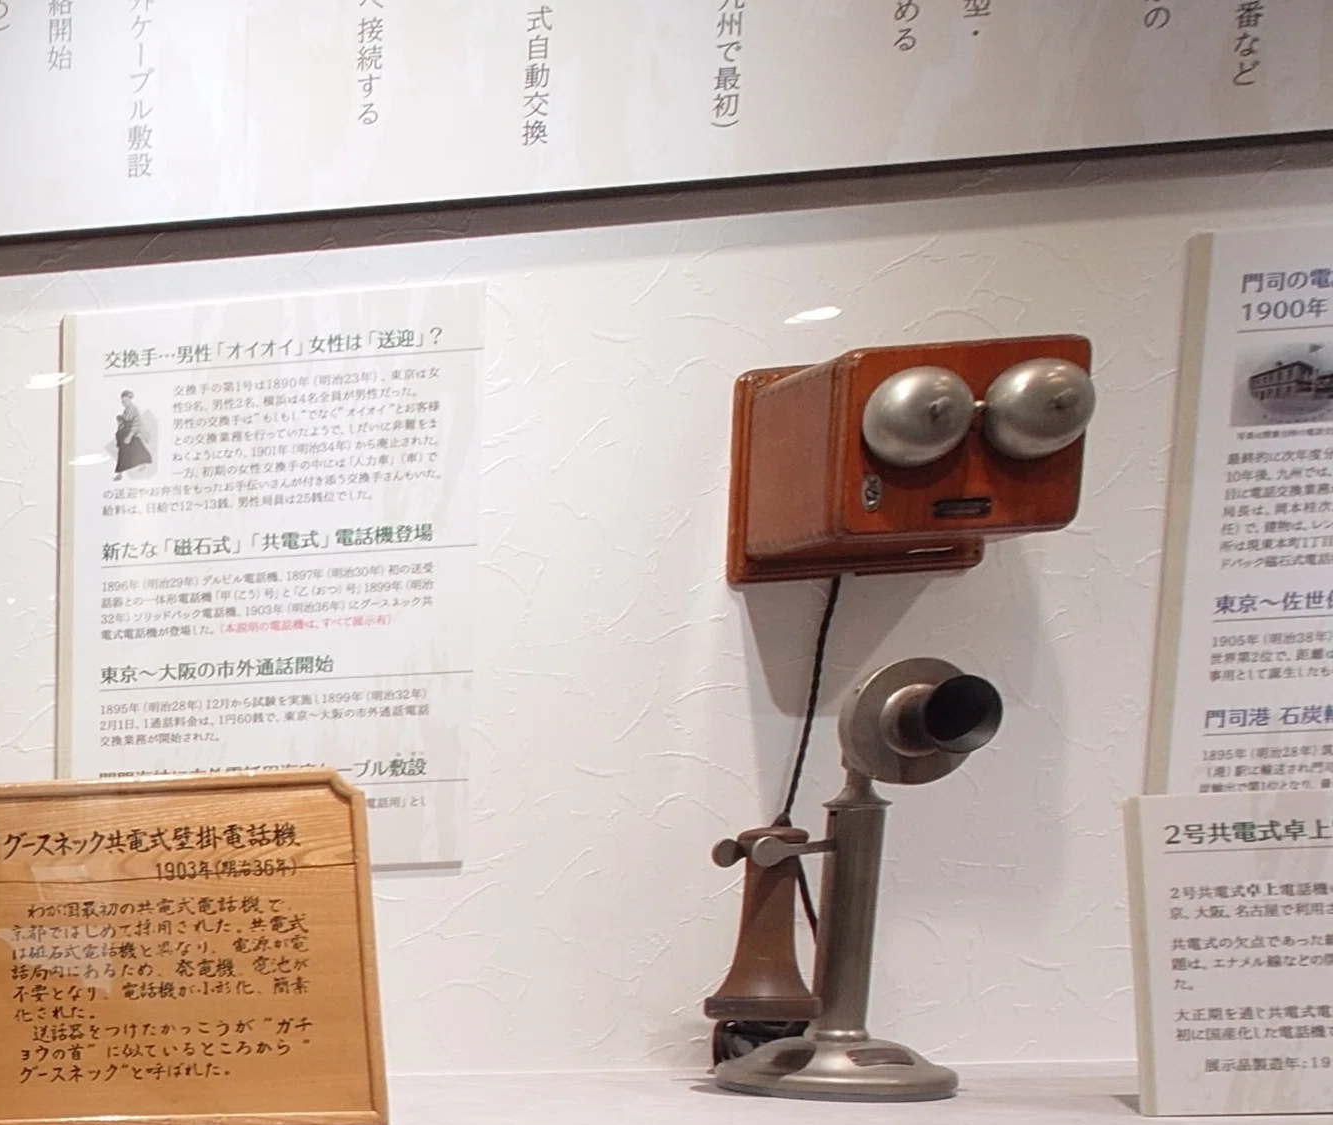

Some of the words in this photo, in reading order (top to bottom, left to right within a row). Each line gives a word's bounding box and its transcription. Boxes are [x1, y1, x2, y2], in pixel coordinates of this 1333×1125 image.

[893, 0, 920, 52] める
[1144, 0, 1171, 30] の
[1231, 0, 1264, 87] 番など
[522, 4, 553, 147] 式自動交換
[1241, 268, 1333, 294] 門司の電
[1242, 297, 1329, 321] 1900年
[1204, 707, 1271, 728] 門司港
[2, 822, 302, 862] グースネック共電式壁掛電話機
[1163, 818, 1333, 845] 2号共電式卓上
[1169, 882, 1333, 900] 2号共電式卓上電話機
[1174, 1005, 1333, 1022] 大正期を通じ共電式電
